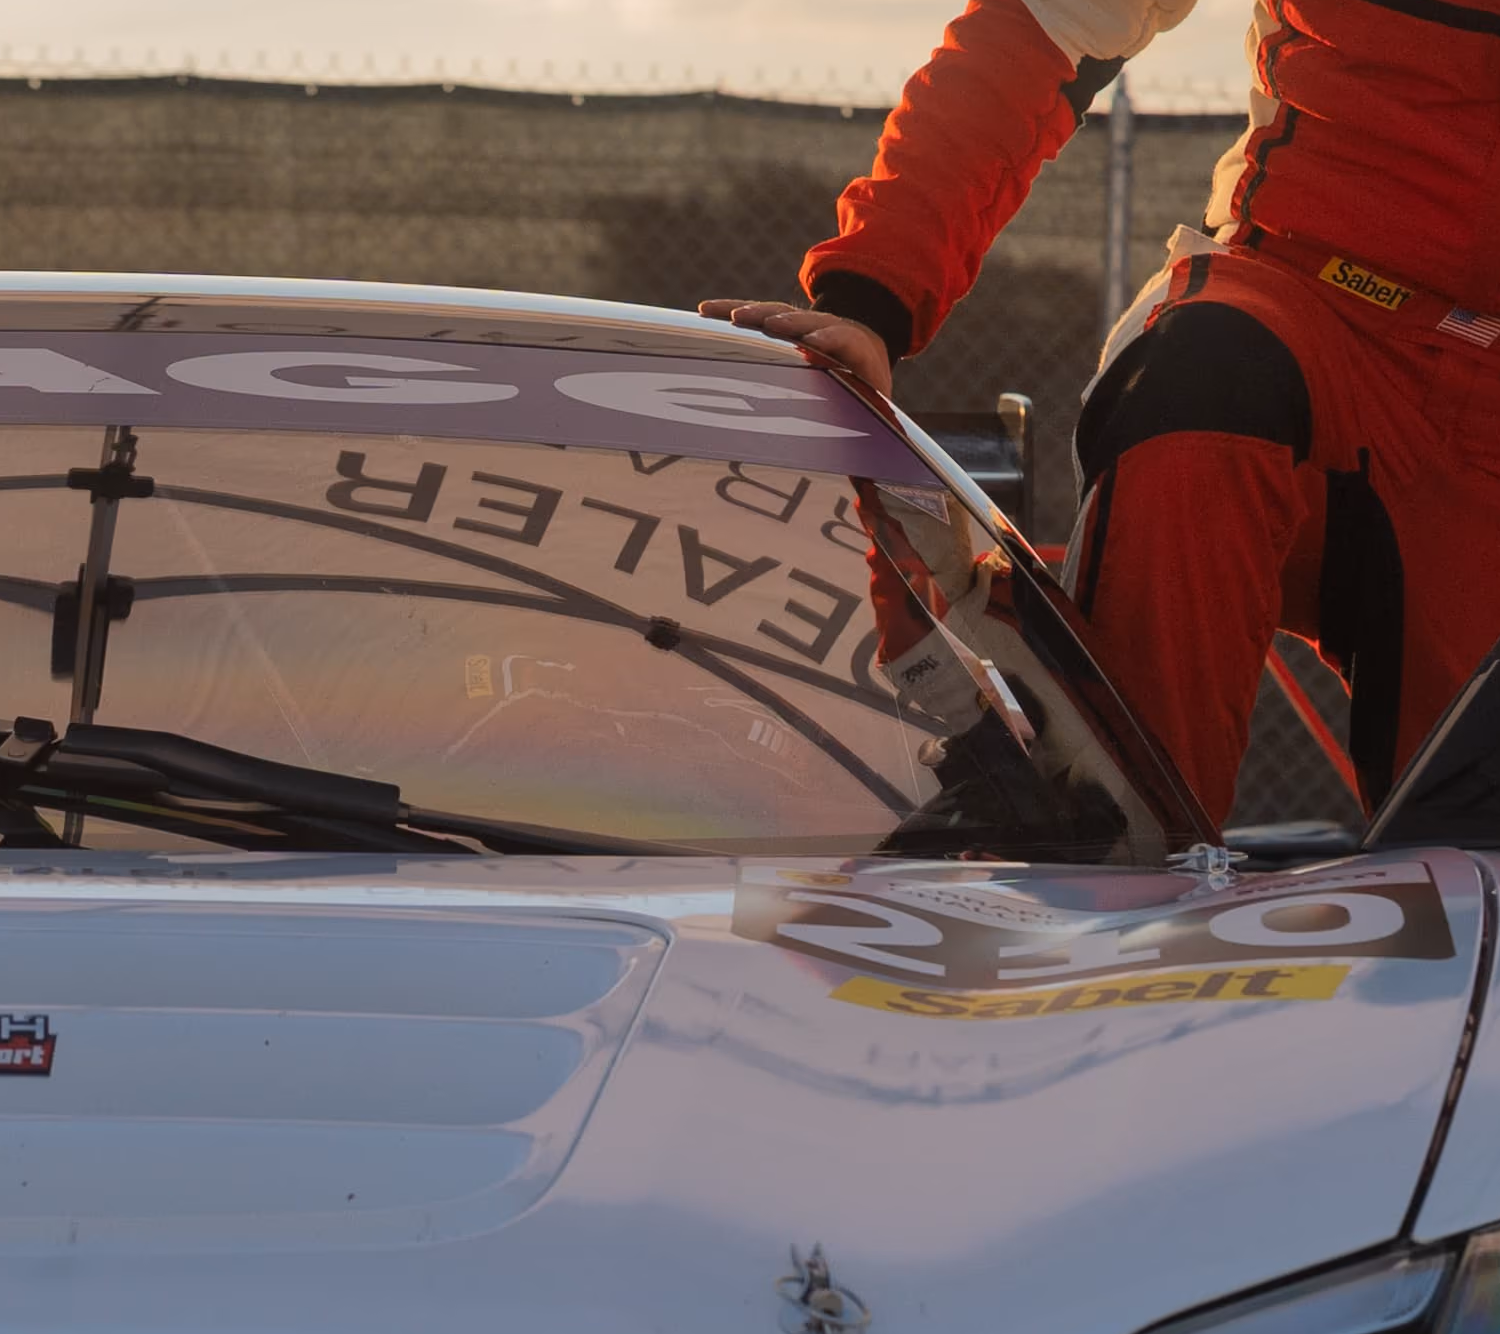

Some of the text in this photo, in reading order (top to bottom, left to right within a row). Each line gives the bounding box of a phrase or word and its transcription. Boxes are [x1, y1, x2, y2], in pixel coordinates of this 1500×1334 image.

[1331, 261, 1412, 308] Sabelt
[776, 890, 1406, 980] 210
[885, 968, 1294, 1019] Sabelt
